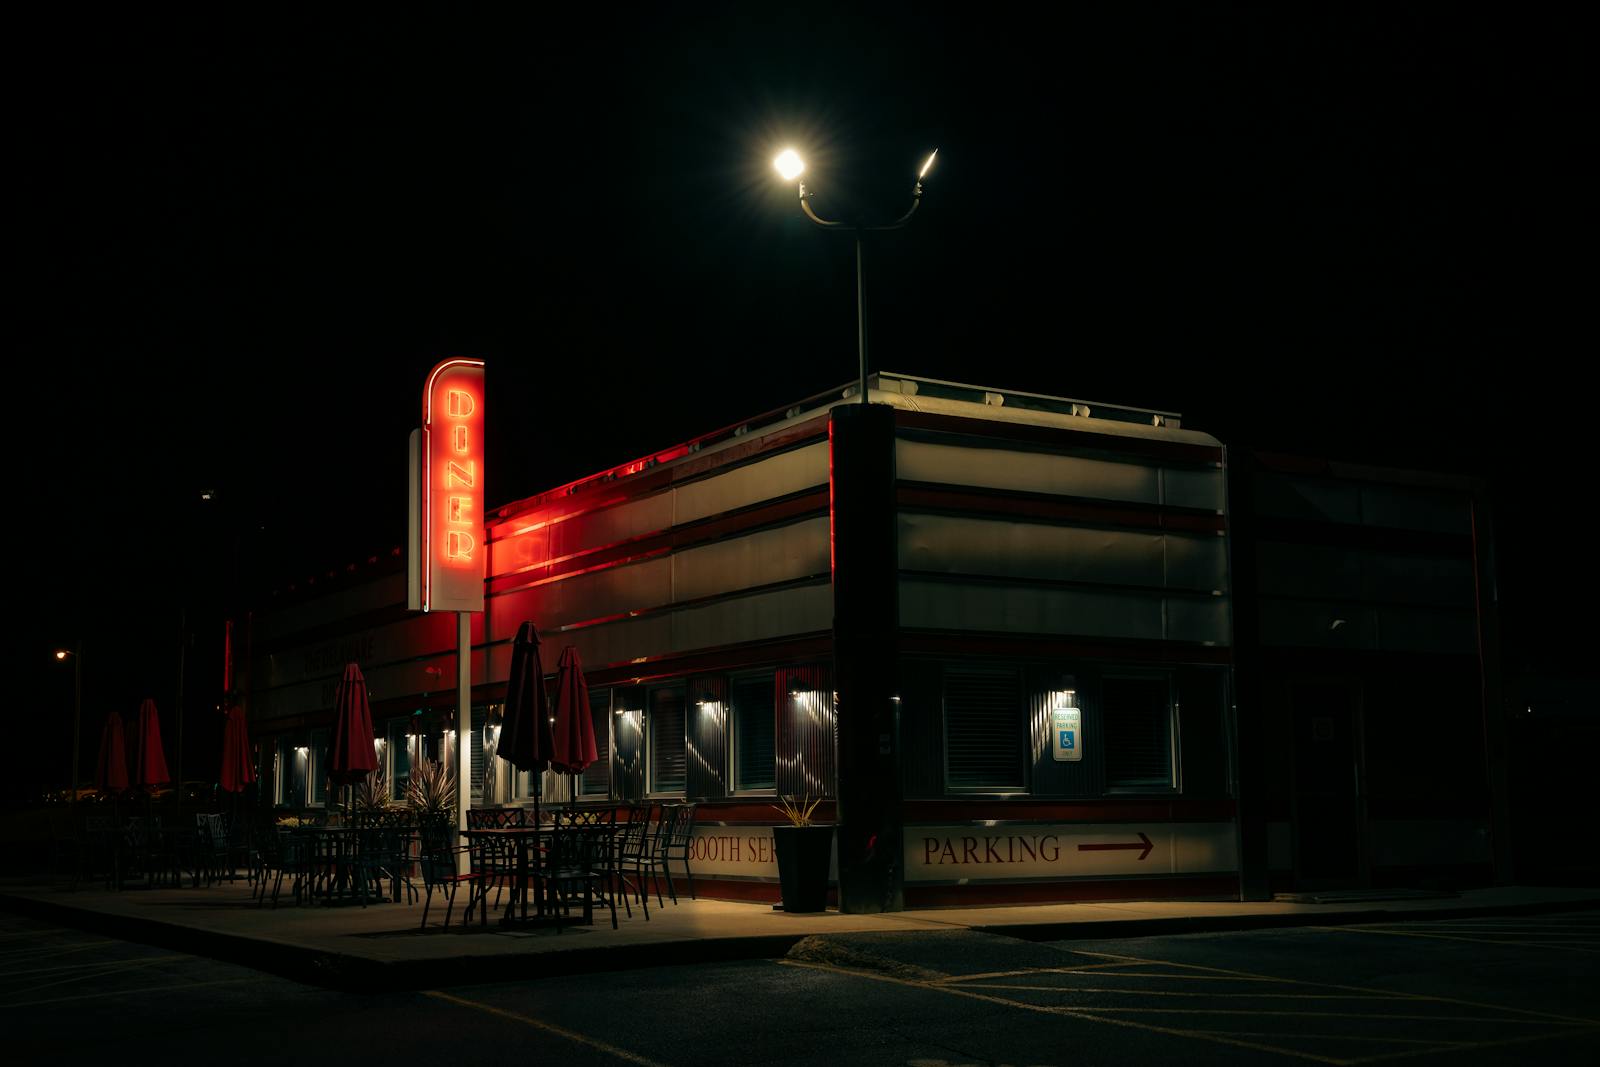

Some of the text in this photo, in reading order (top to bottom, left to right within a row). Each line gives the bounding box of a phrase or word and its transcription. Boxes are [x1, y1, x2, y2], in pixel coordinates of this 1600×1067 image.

[448, 391, 475, 559] DINER
[1055, 713, 1079, 721] RESERVED
[687, 836, 740, 862] BOOTH
[923, 836, 1060, 865] PARKING
